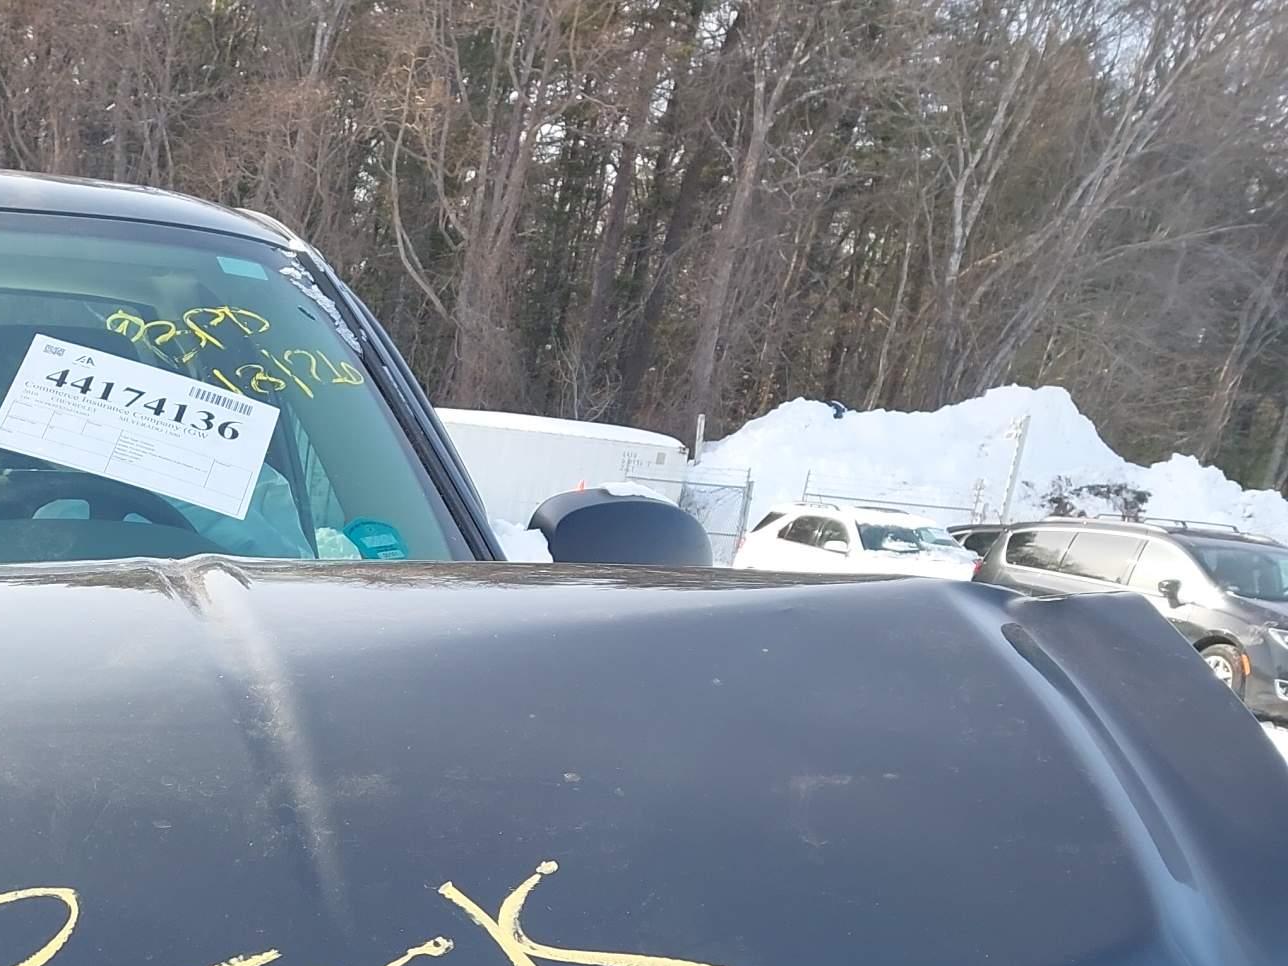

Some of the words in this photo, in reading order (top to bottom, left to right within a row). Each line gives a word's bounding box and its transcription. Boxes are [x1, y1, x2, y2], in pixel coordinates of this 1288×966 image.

[45, 367, 243, 441] 44174136
[81, 396, 130, 416] Insurance
[131, 410, 181, 432] Company
